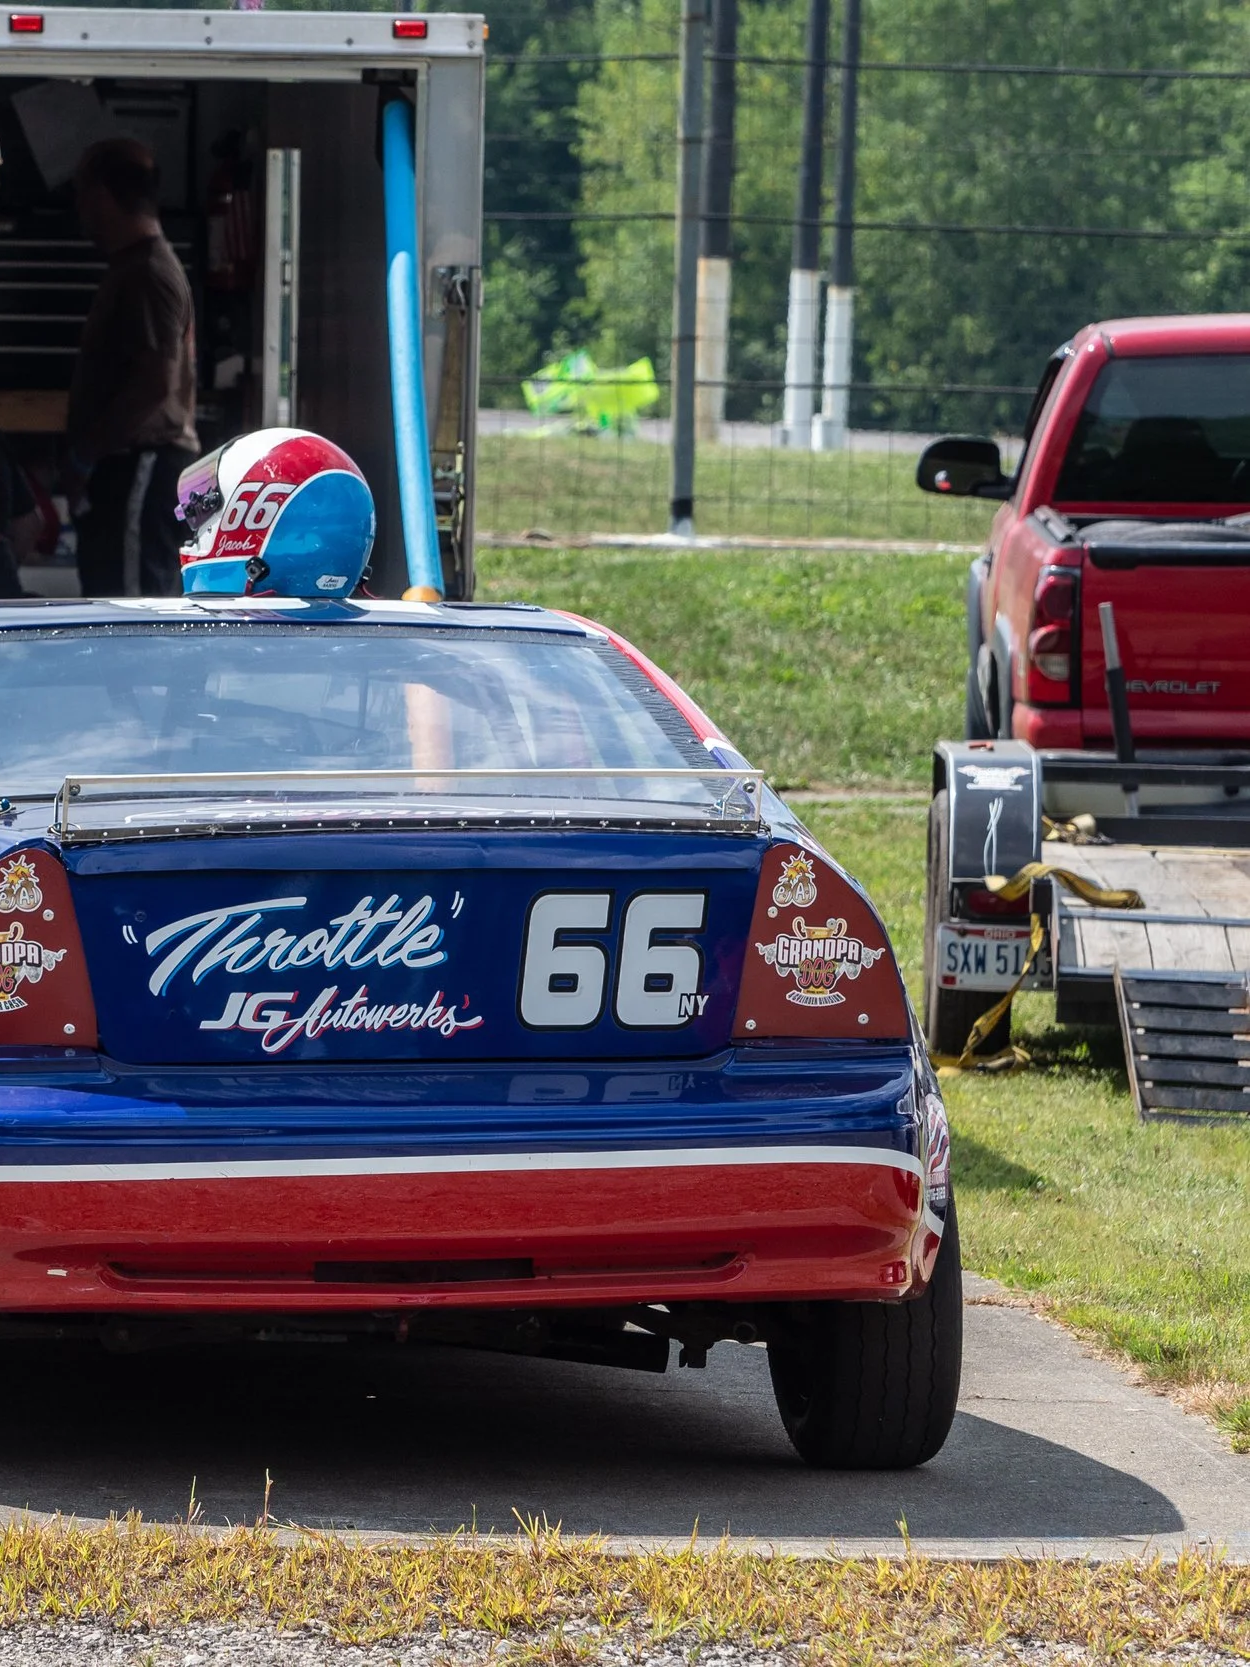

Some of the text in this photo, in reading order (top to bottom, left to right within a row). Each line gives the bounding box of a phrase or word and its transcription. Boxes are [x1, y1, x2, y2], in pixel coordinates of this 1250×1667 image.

[220, 482, 297, 532] 66
[216, 534, 256, 557] Jacob
[517, 890, 708, 1030] 66
[777, 937, 860, 965] GRANDPA
[947, 942, 987, 974] SXW
[799, 957, 835, 987] DOG
[3, 997, 26, 1010] CASH
[199, 991, 299, 1031] JG
[679, 993, 710, 1017] NY
